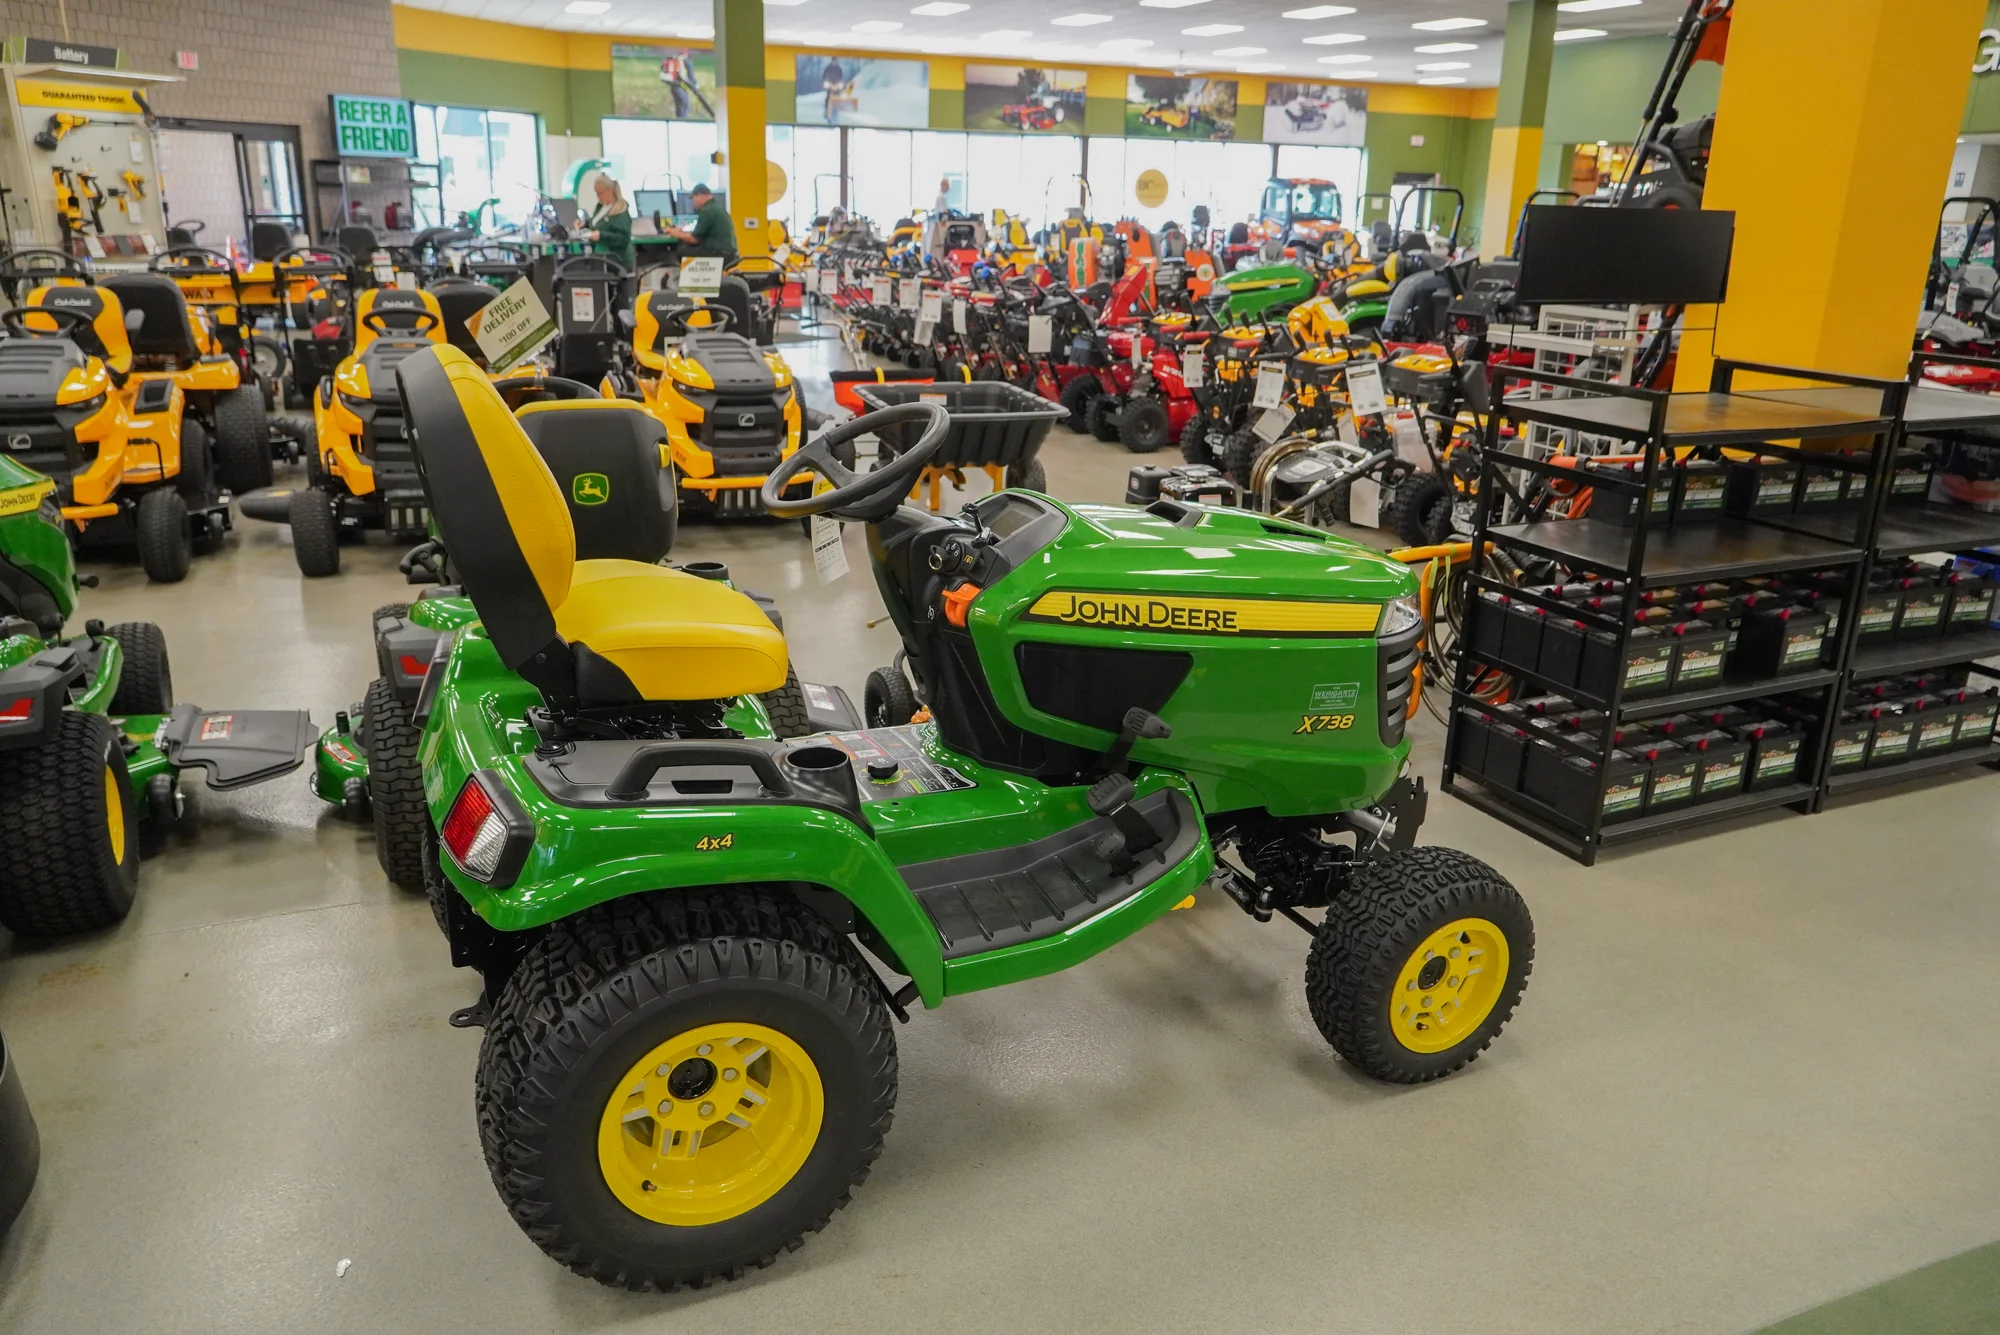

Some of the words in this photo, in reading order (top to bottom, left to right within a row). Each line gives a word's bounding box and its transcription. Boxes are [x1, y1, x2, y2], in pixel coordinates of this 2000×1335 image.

[54, 46, 89, 65] Battery
[42, 90, 96, 102] GUARANTEED
[338, 99, 392, 124] REFER
[396, 104, 408, 125] A
[340, 125, 410, 151] FRIEND
[483, 296, 527, 334] DELIVERY
[488, 296, 513, 318] FREE
[498, 329, 518, 344] $100
[516, 316, 532, 332] OFF
[0, 498, 18, 509] JOHN
[17, 492, 36, 504] DEERE
[1060, 595, 1140, 623] JOHN
[1148, 600, 1238, 630] DEERE
[1314, 689, 1357, 698] WEINGARTZ
[1294, 714, 1356, 734] X738
[695, 832, 734, 851] 4x4
